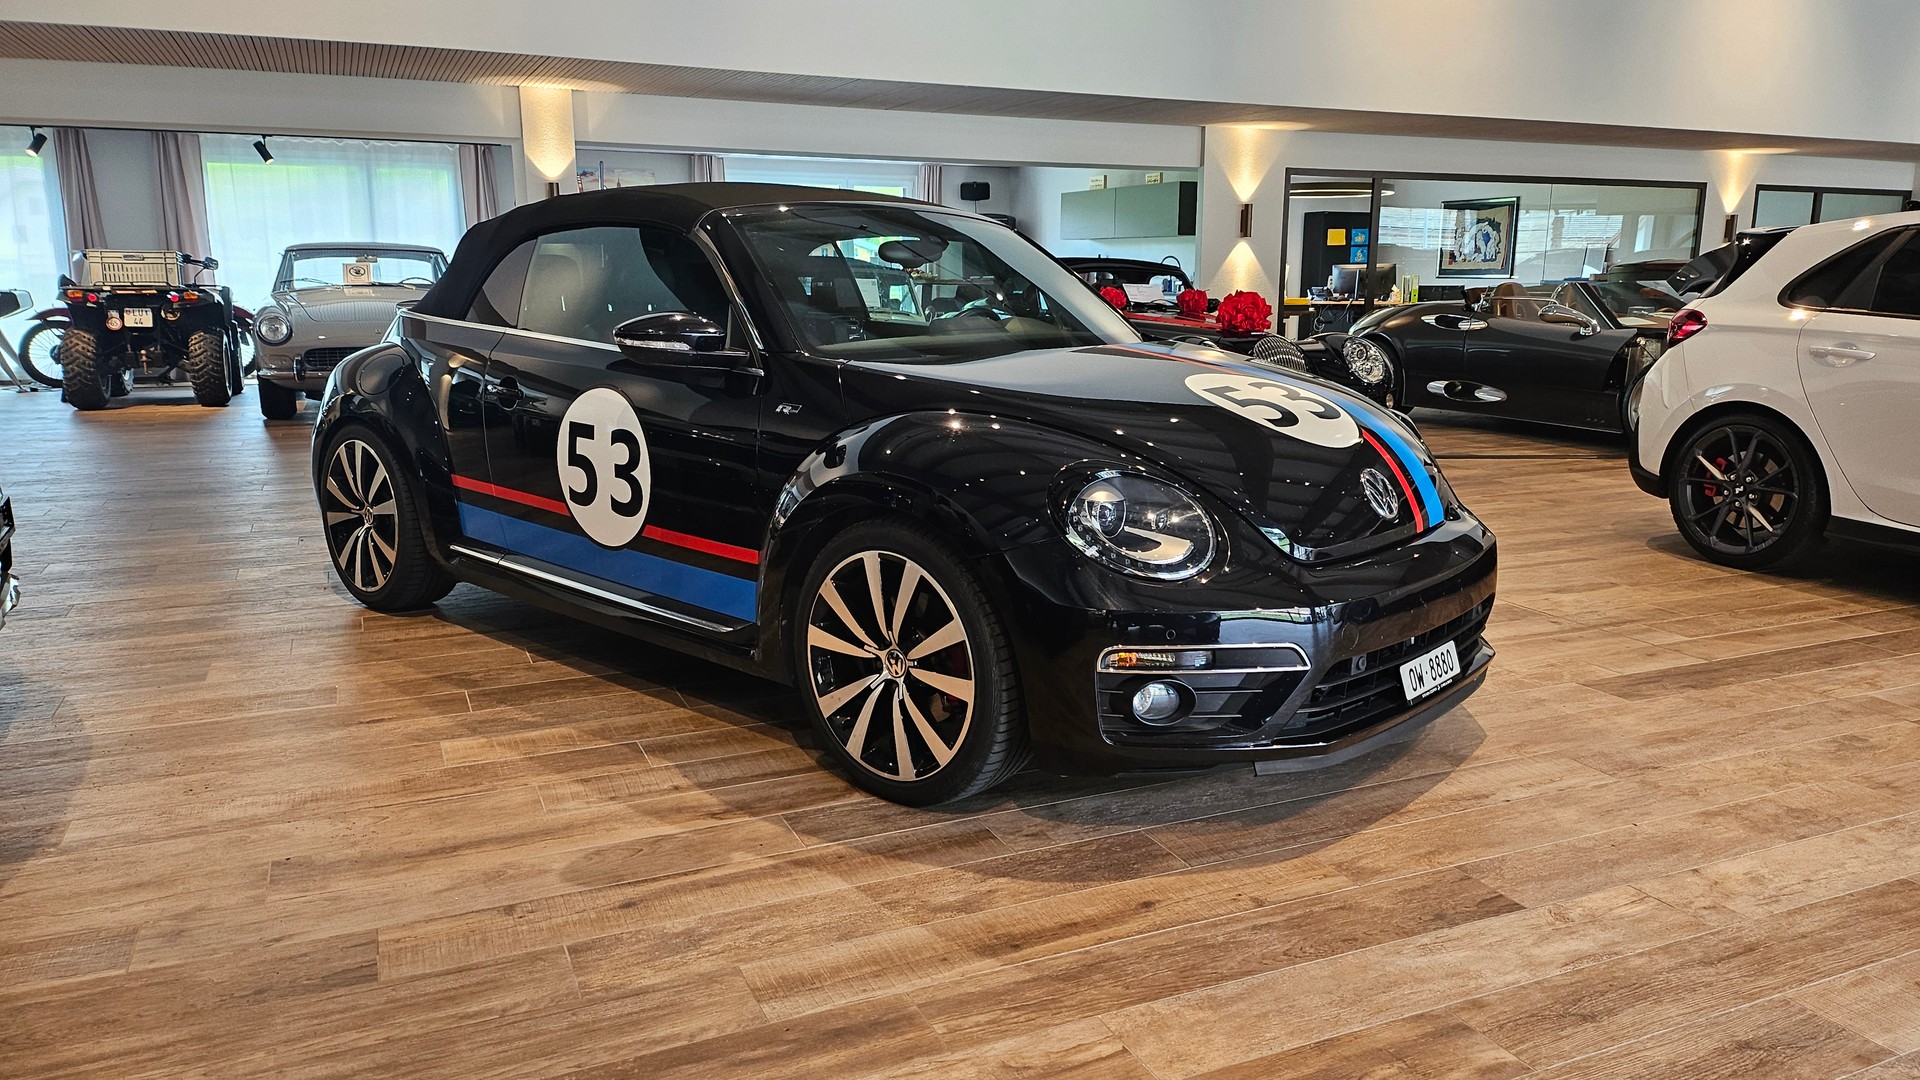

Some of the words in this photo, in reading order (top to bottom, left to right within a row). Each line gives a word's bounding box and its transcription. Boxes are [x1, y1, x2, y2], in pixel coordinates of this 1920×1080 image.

[132, 309, 144, 317] LU
[1202, 377, 1342, 428] 53
[567, 420, 643, 518] 53
